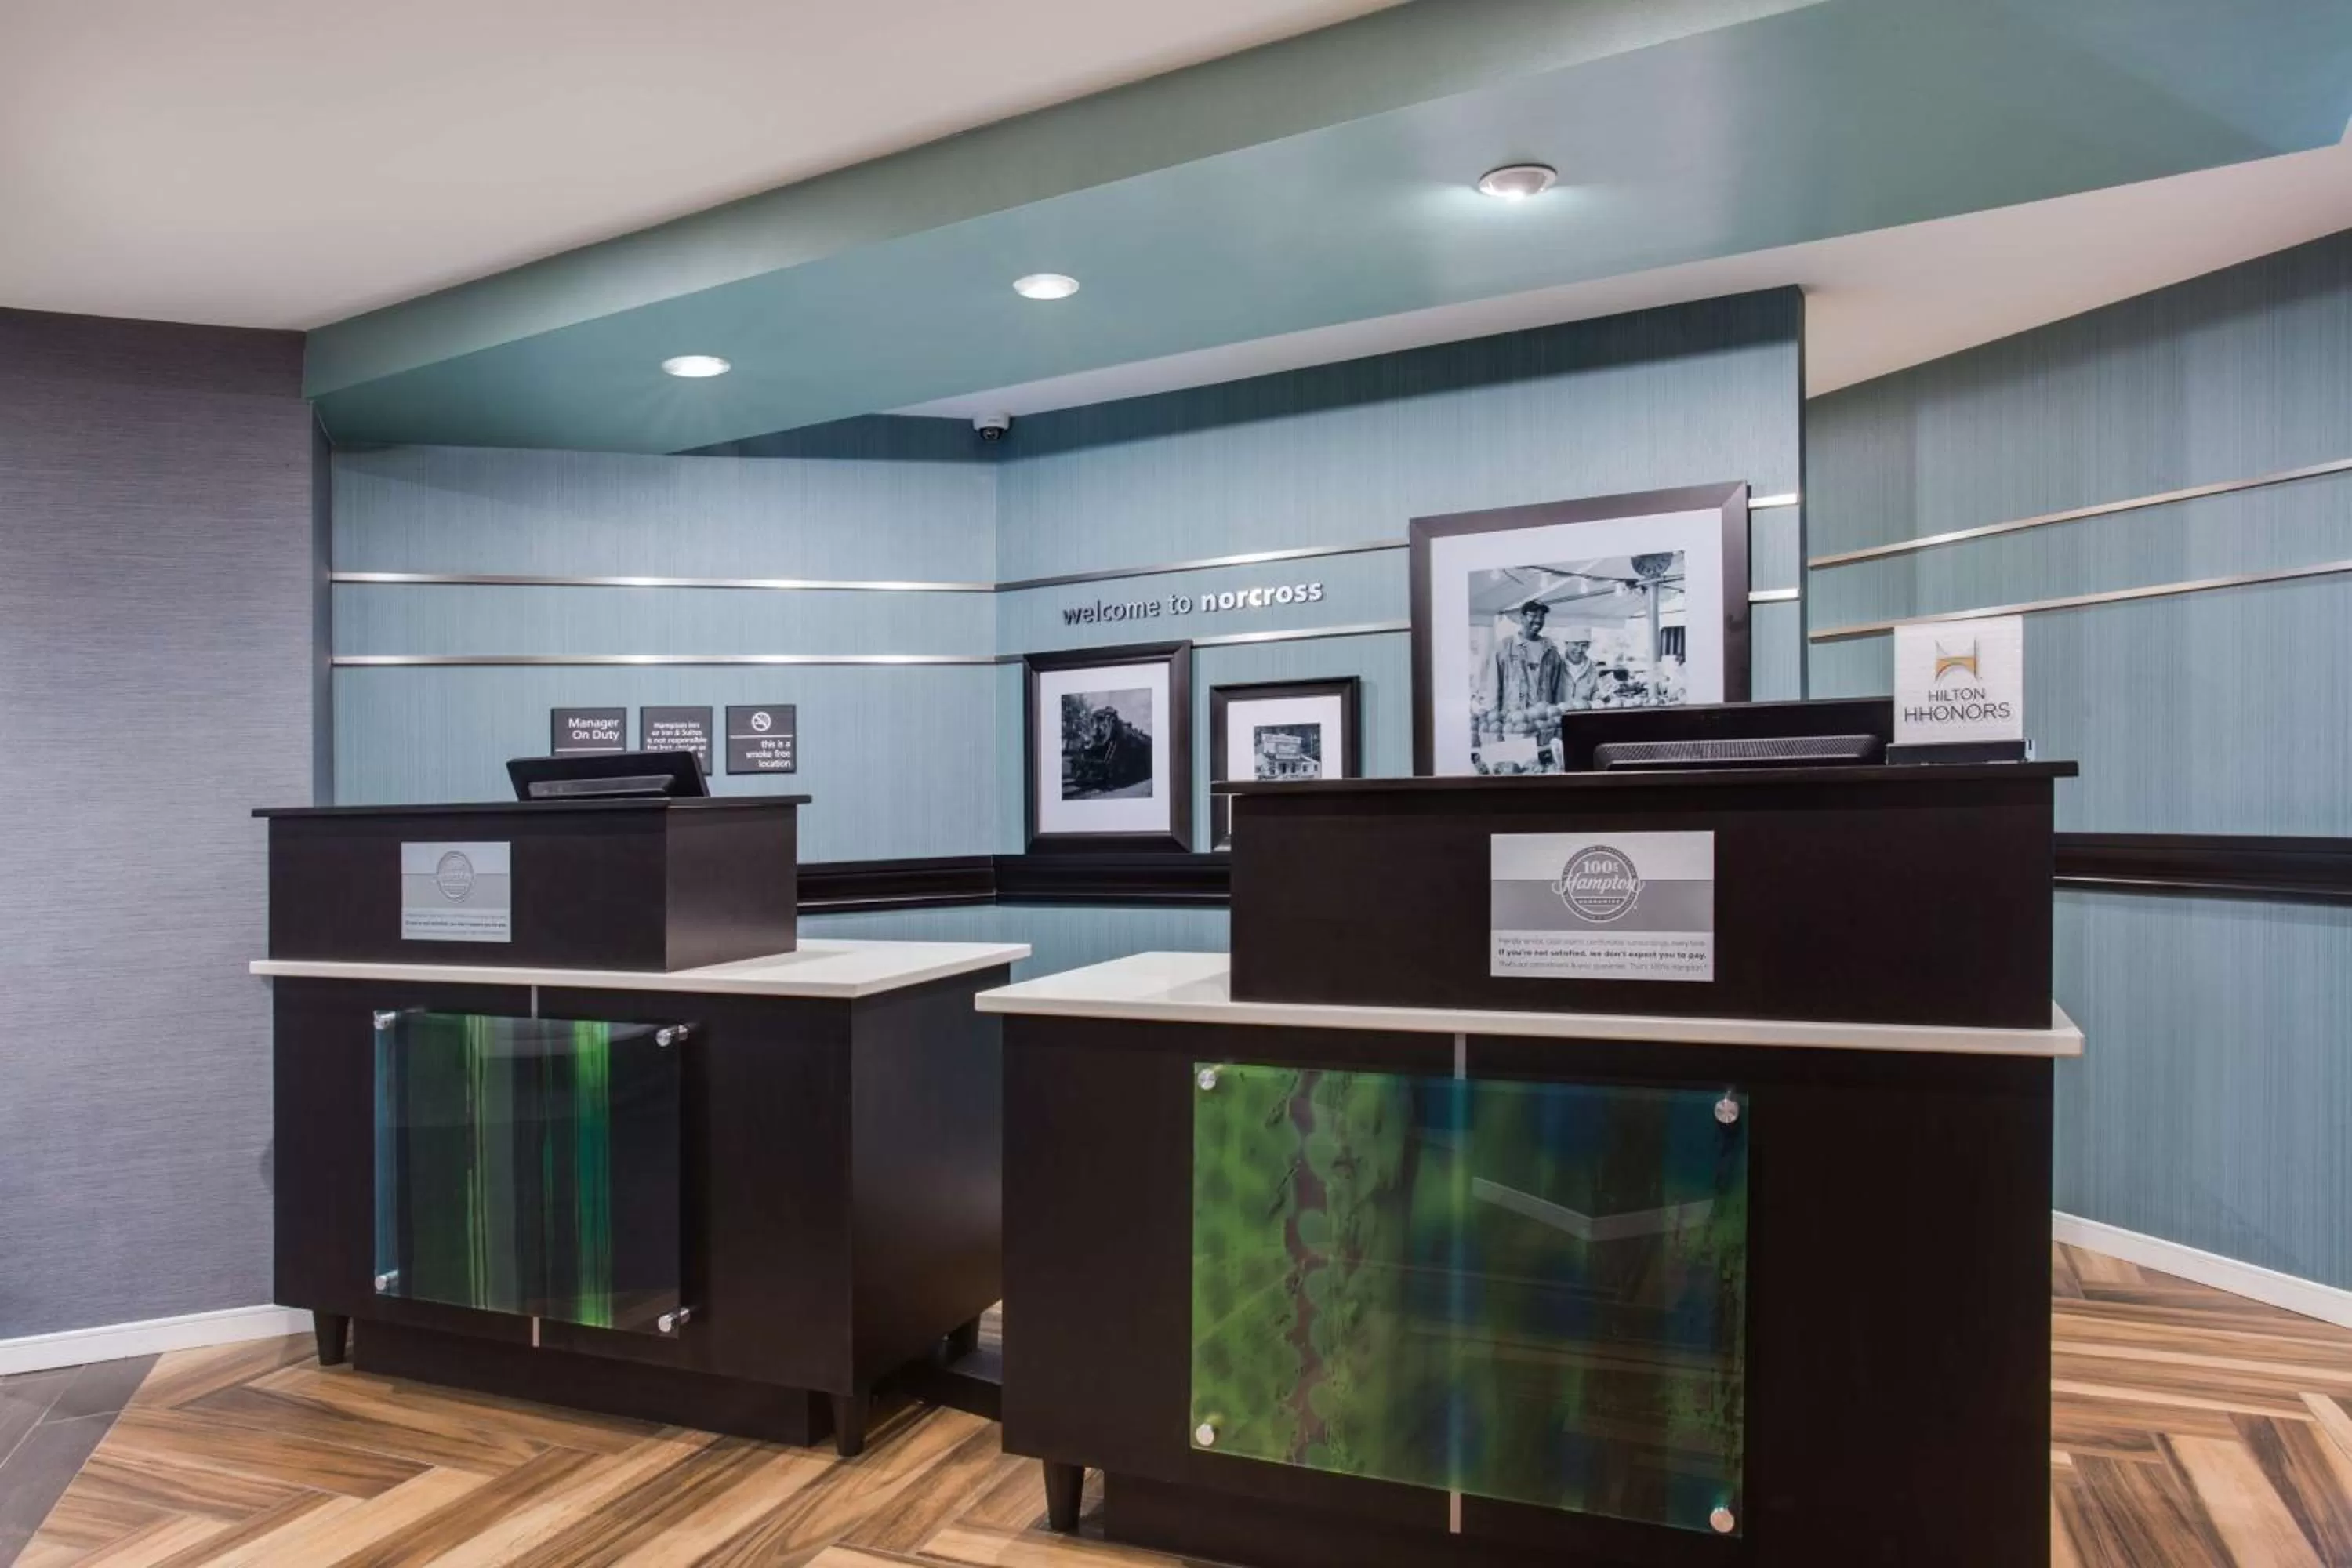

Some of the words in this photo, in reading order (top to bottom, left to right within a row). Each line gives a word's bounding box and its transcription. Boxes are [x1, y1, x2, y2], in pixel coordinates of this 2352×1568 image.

[1063, 600, 1161, 626] welcome
[1169, 594, 1192, 615] to
[1201, 581, 1324, 612] norcross
[1928, 688, 1986, 702] HILTON
[1904, 702, 2011, 723] HHONORS
[568, 717, 620, 730] Manager
[572, 730, 590, 739] On
[592, 730, 620, 742] Duty
[667, 737, 707, 746] responsible
[760, 739, 776, 749] this
[777, 739, 783, 748] is
[746, 749, 772, 759] smoke
[774, 749, 791, 758] free
[758, 759, 791, 768] location
[1552, 871, 1645, 895] Hampton
[1659, 952, 1675, 960] you
[1688, 953, 1707, 961] pay.
